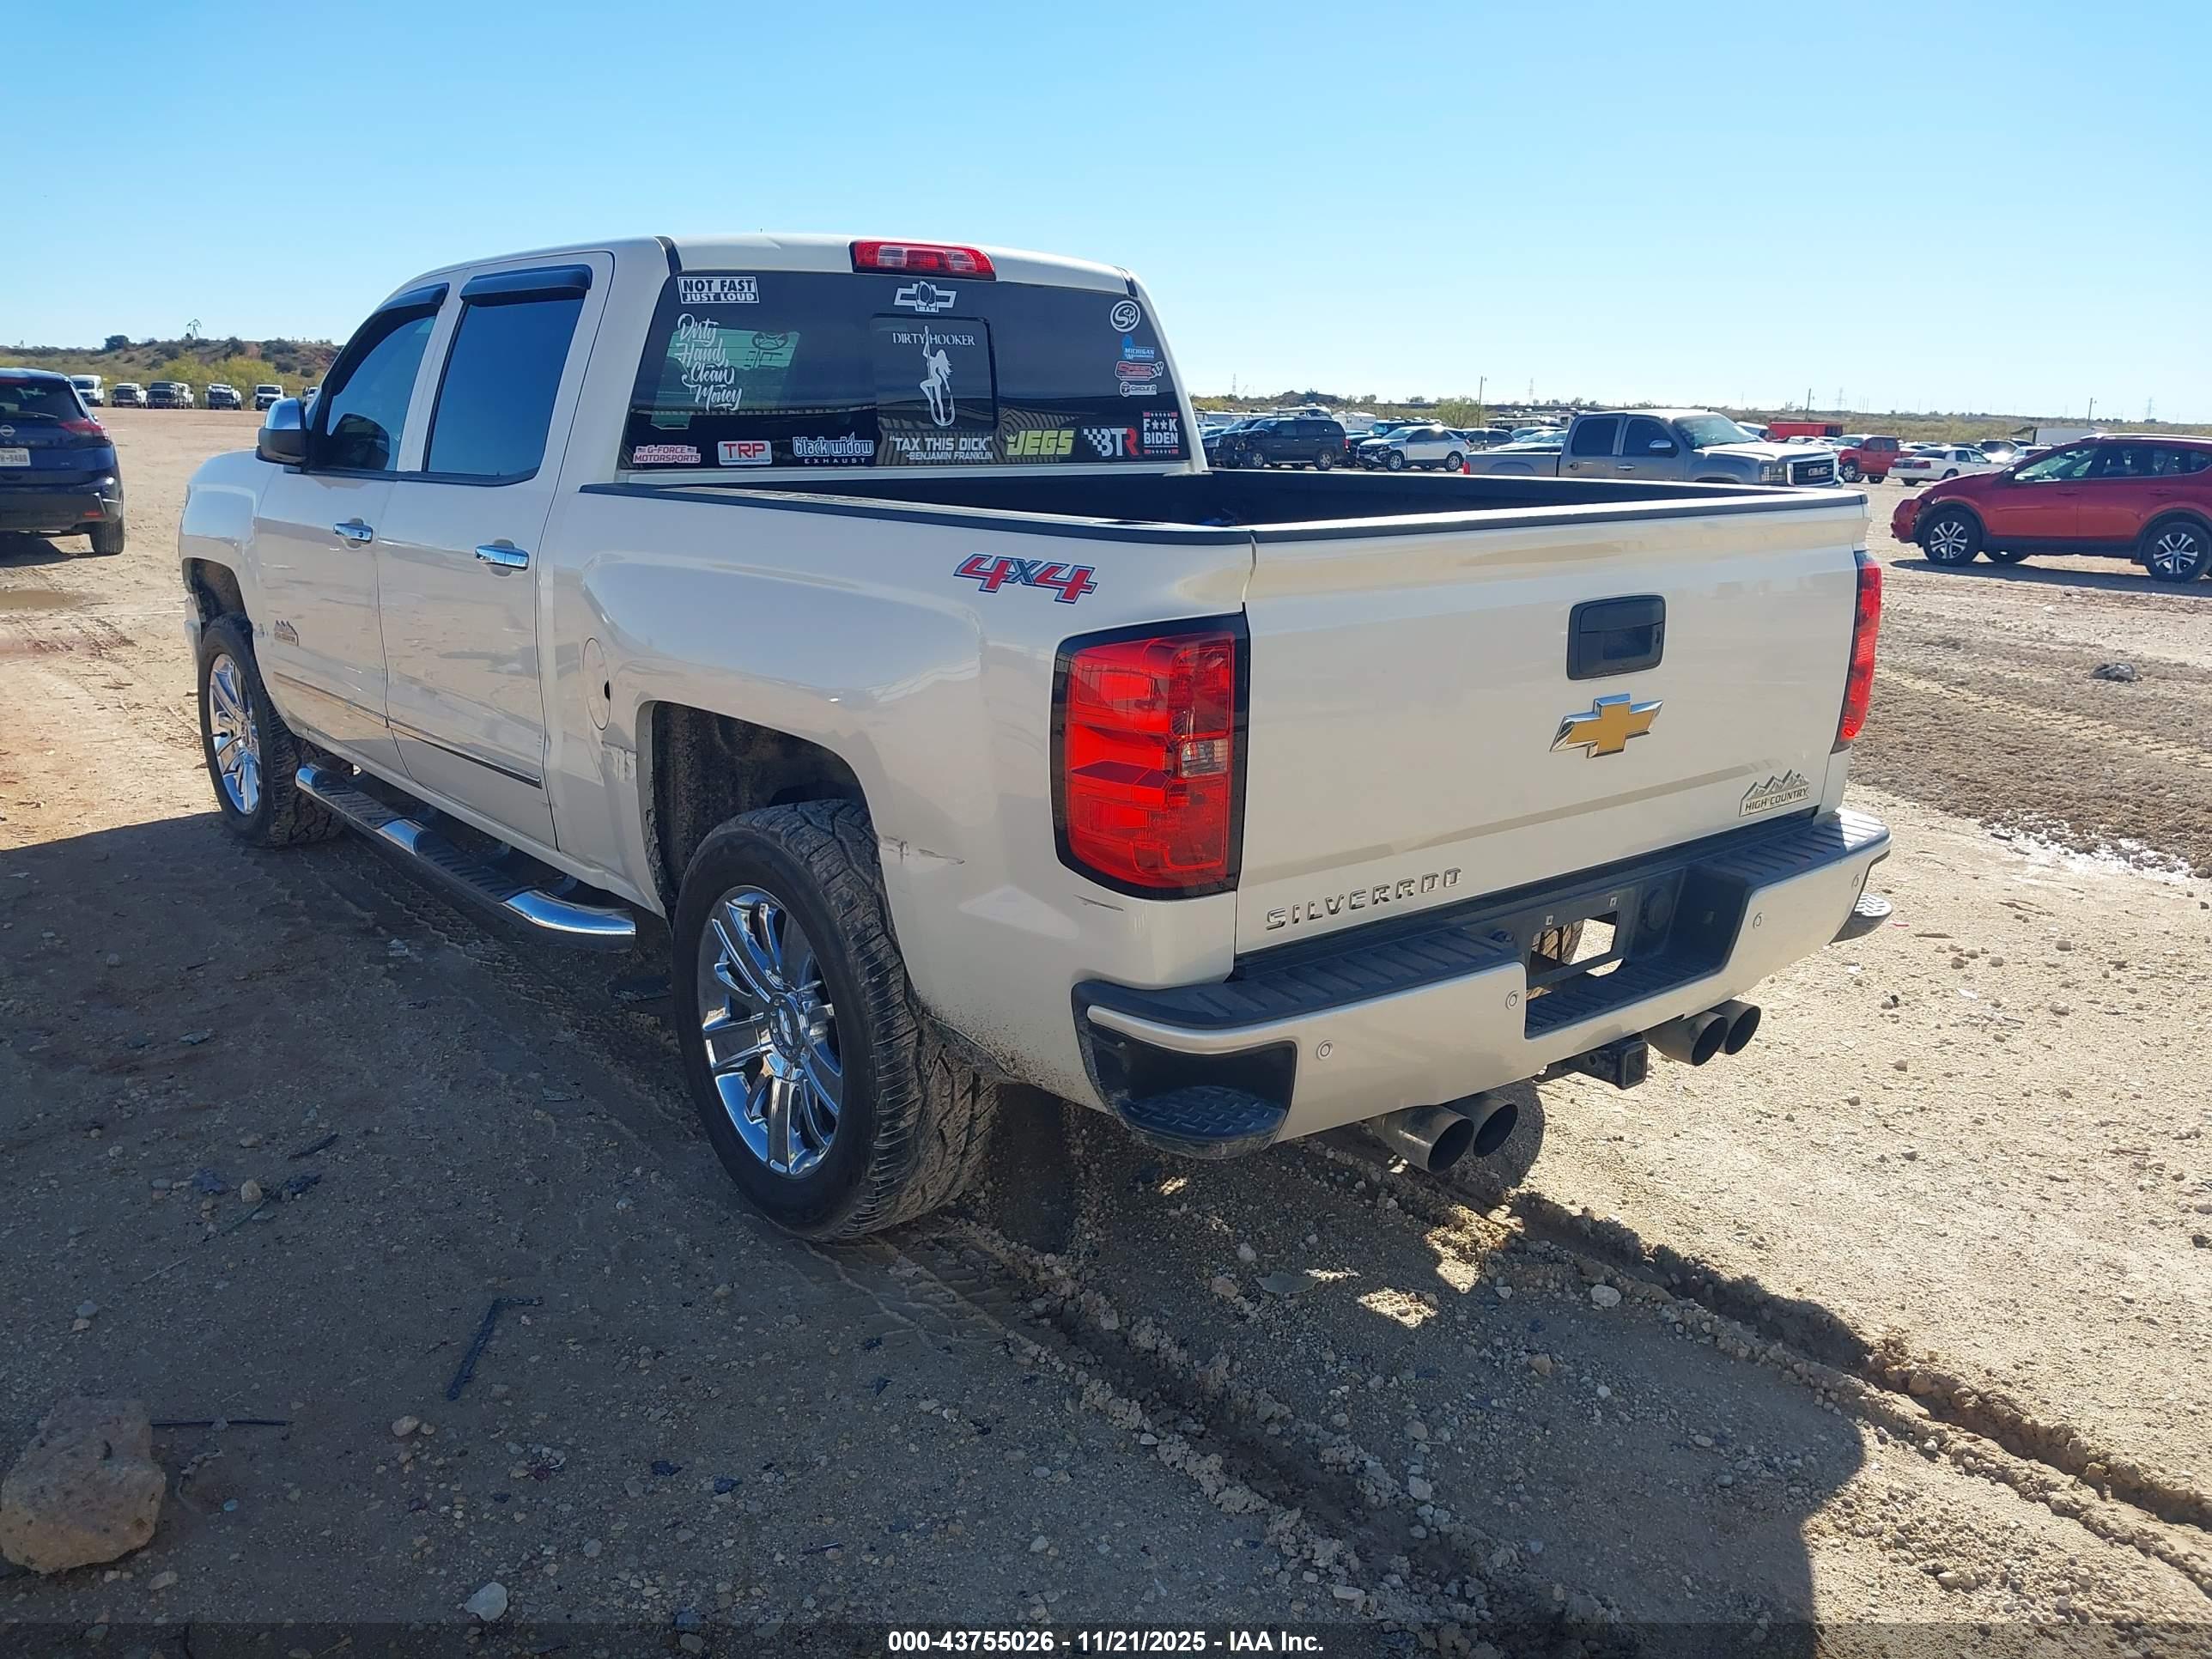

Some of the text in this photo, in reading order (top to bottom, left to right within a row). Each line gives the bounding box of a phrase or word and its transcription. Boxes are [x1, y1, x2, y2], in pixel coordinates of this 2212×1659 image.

[684, 279, 753, 292] NOT FAST
[685, 293, 755, 301] JUST LOUD
[677, 313, 720, 347] Dirty
[893, 332, 975, 345] DIRTY HOOKER
[690, 362, 735, 385] Clean
[682, 374, 743, 412] Money
[792, 432, 874, 457] black widow
[925, 438, 955, 451] THIS
[1006, 430, 1074, 456] JEGS
[1084, 428, 1139, 456] BTR
[1143, 432, 1179, 445] BIDEN
[634, 453, 700, 463] MOTORSPORTS
[723, 442, 766, 459] TRP
[954, 452, 994, 460] FRANKLIN
[1745, 787, 1808, 811] HIGH COUNTRY
[1266, 867, 1462, 930] SILVERADO
